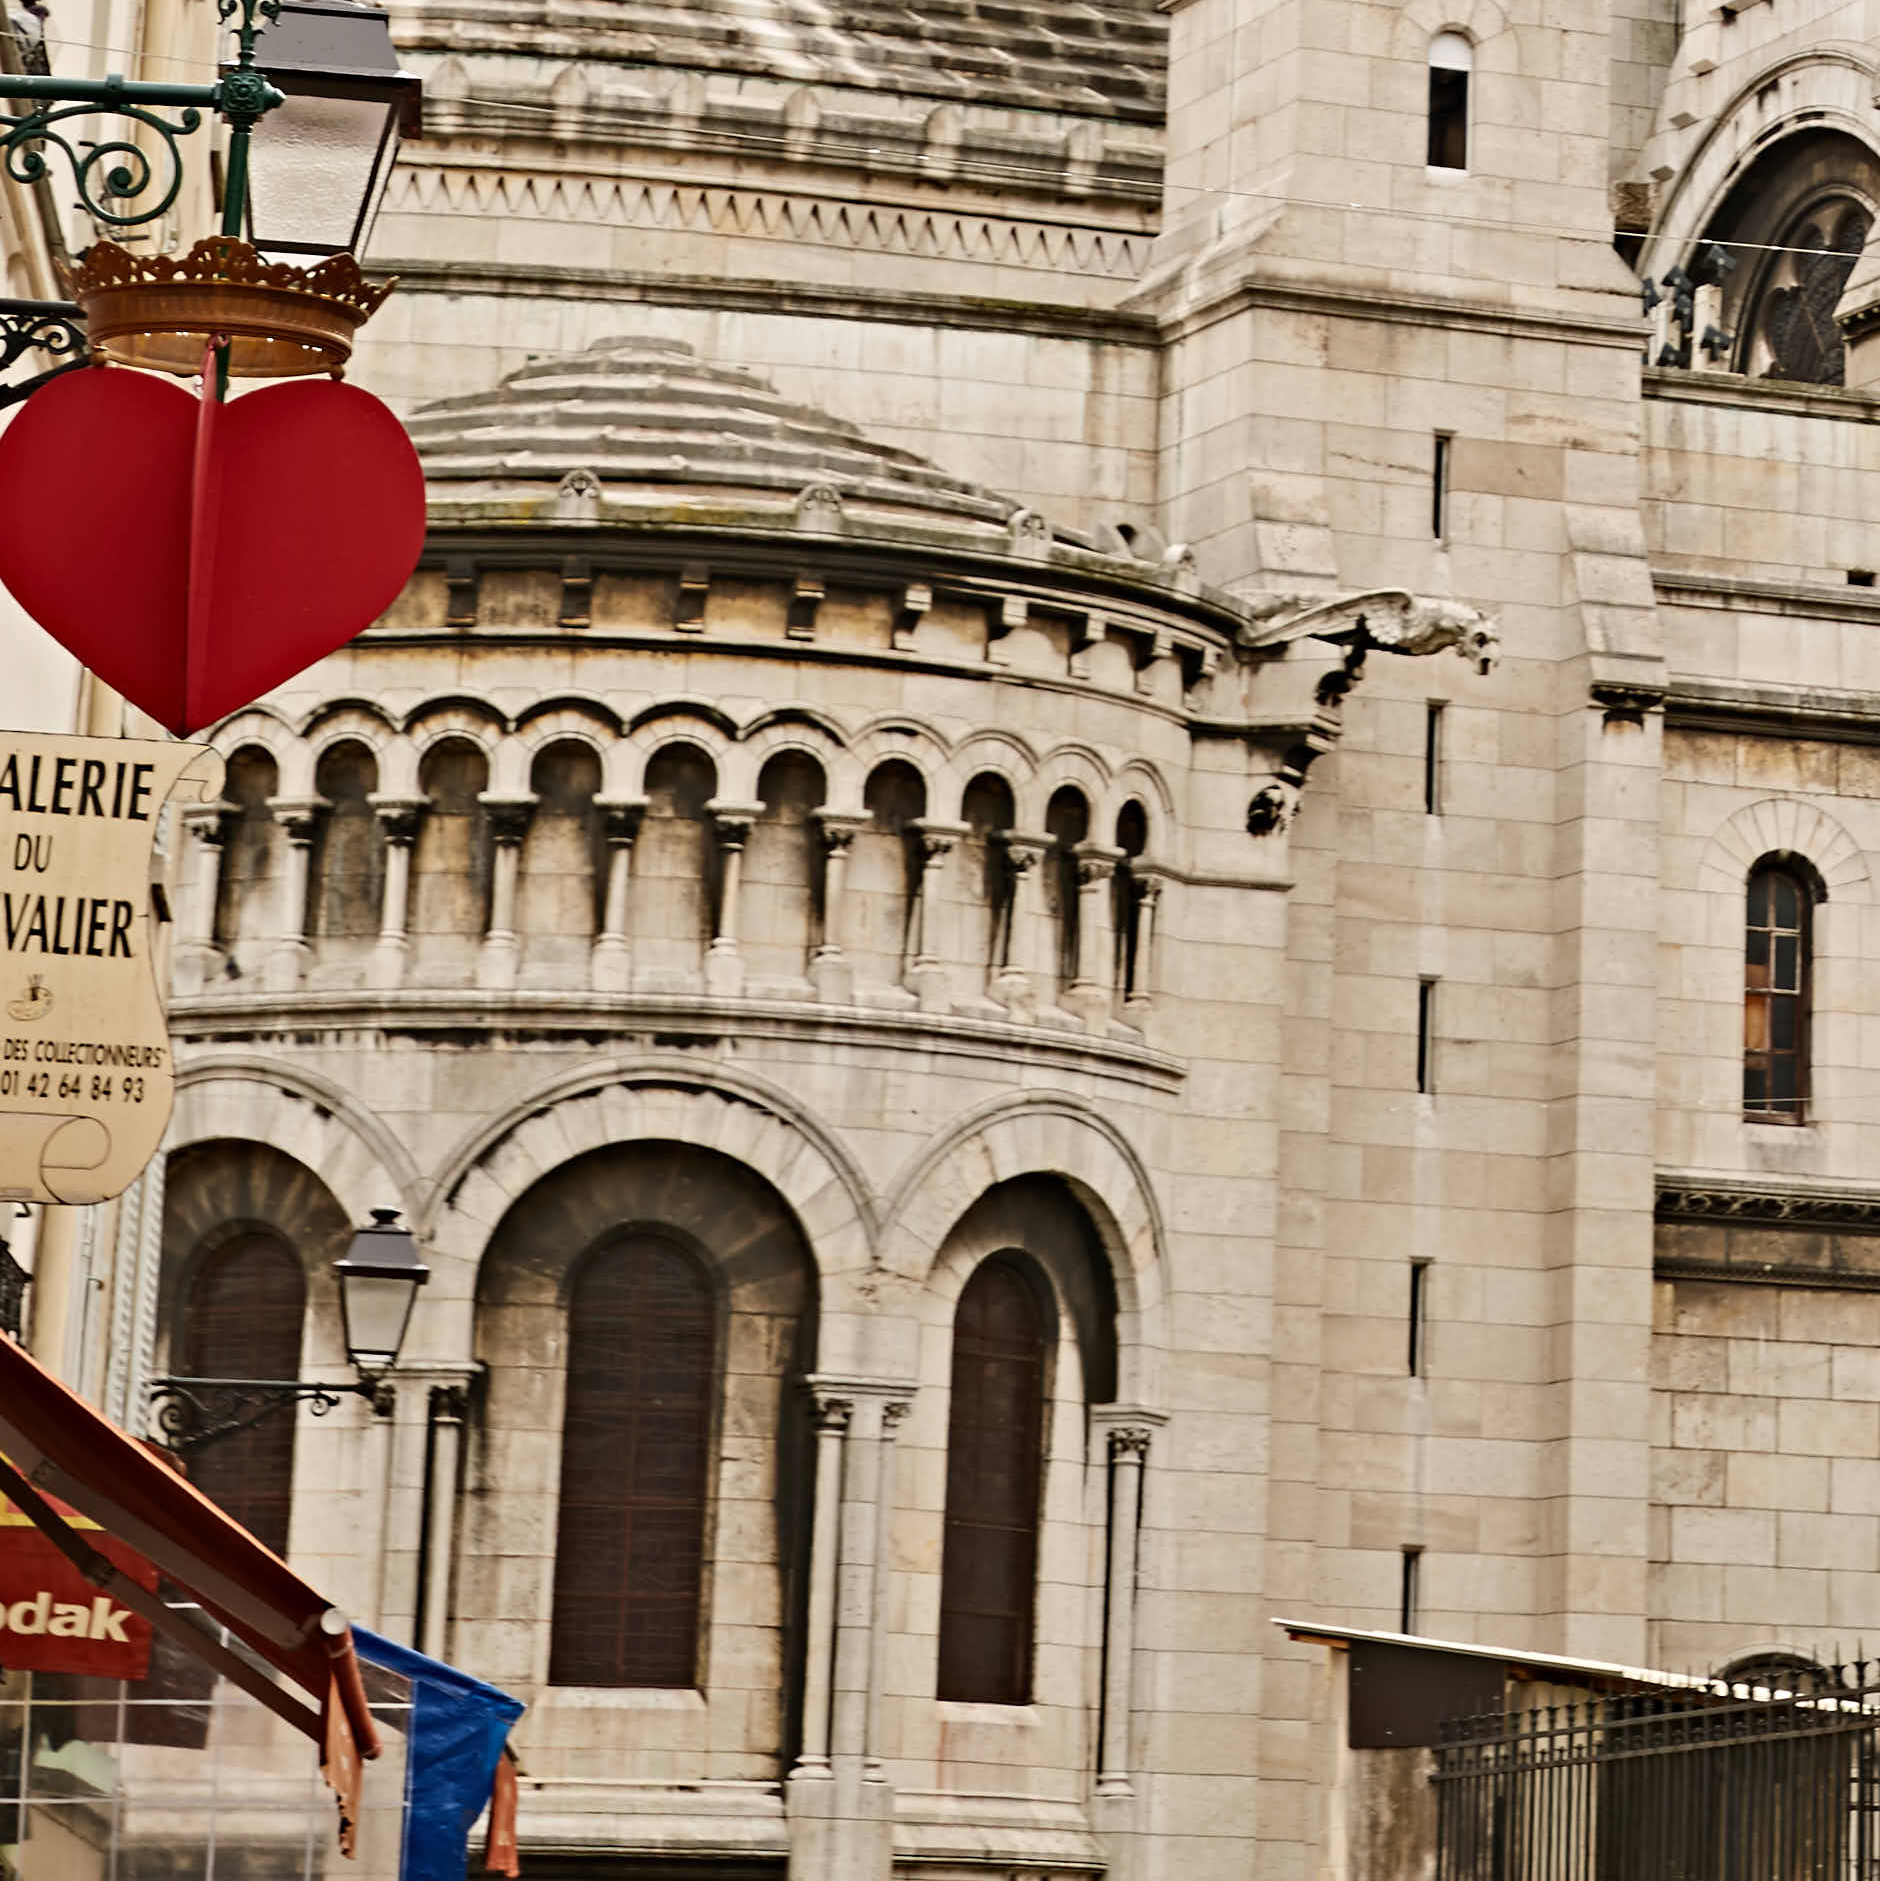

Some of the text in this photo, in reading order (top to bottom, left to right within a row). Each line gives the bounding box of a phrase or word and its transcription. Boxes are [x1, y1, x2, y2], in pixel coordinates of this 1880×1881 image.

[14, 833, 53, 873] DU
[4, 1038, 29, 1061] DES
[1, 1070, 144, 1103] 01 42 64 84 93
[0, 1591, 134, 1642] dak
